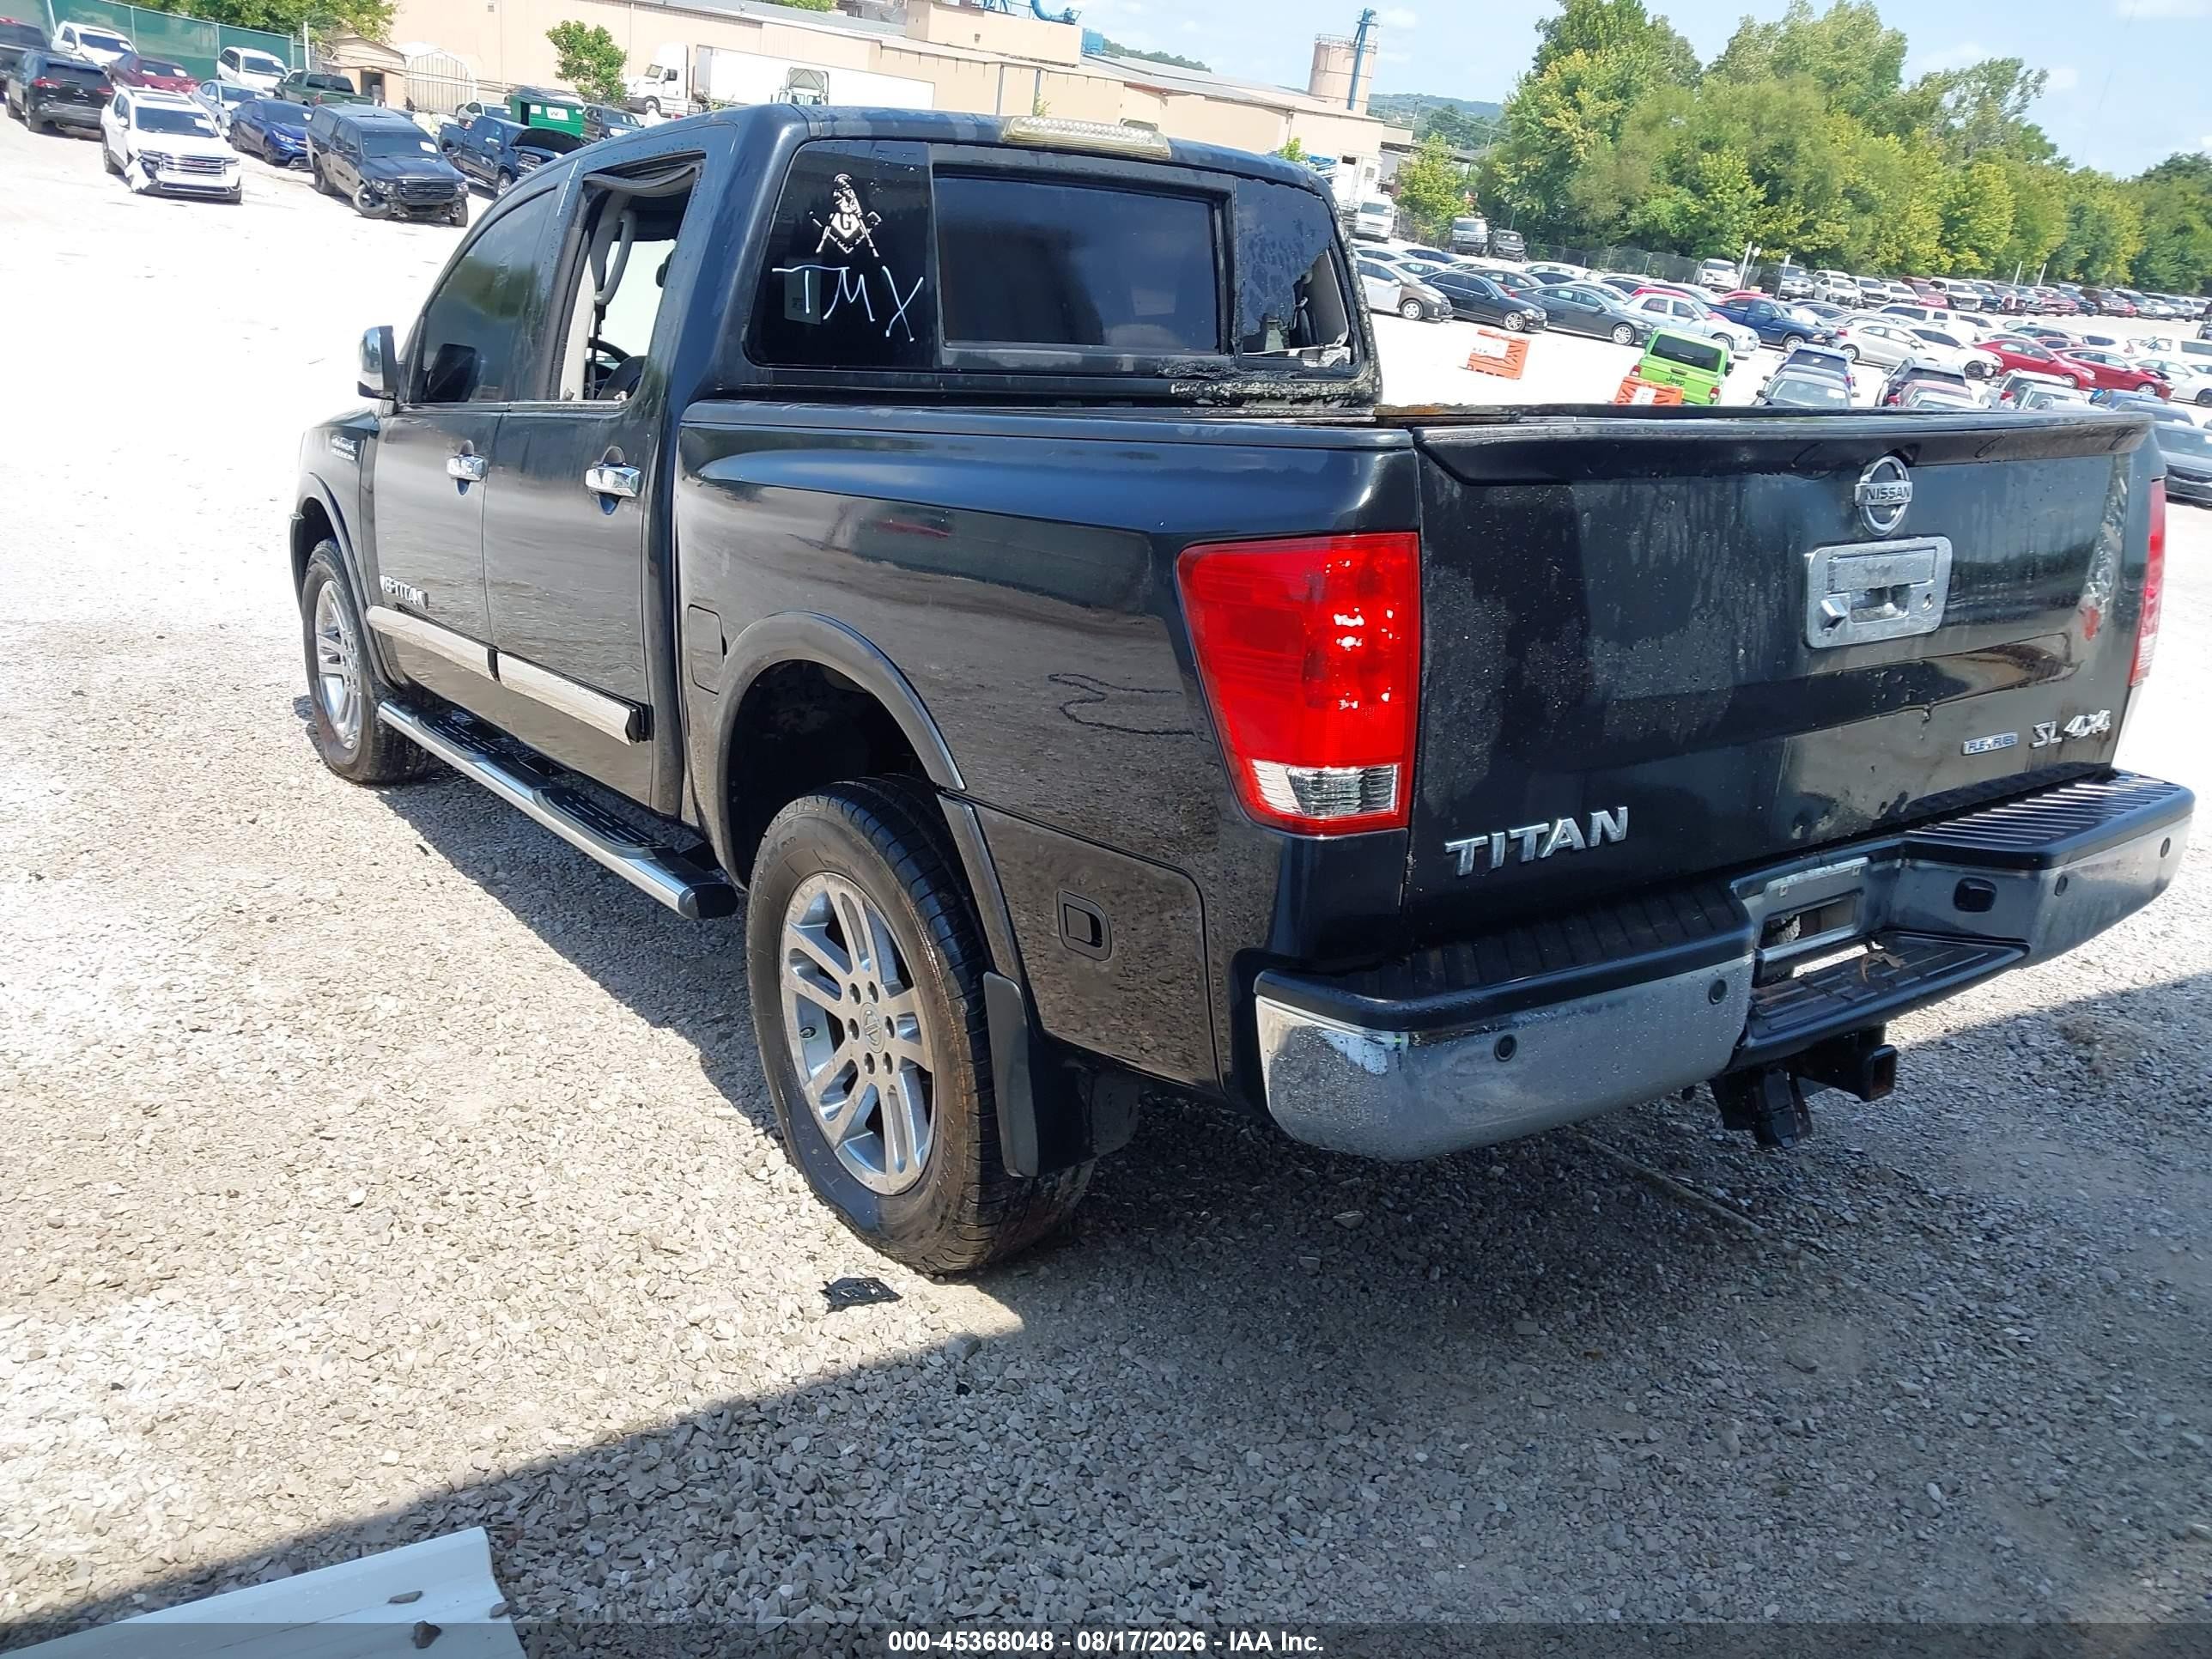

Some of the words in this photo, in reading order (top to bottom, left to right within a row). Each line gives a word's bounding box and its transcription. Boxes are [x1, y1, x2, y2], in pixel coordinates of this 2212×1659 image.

[1665, 375, 1686, 386] Jeep
[1865, 485, 1911, 501] NISSAN
[2028, 720, 2063, 750] SL
[1443, 805, 1629, 877] TITAN
